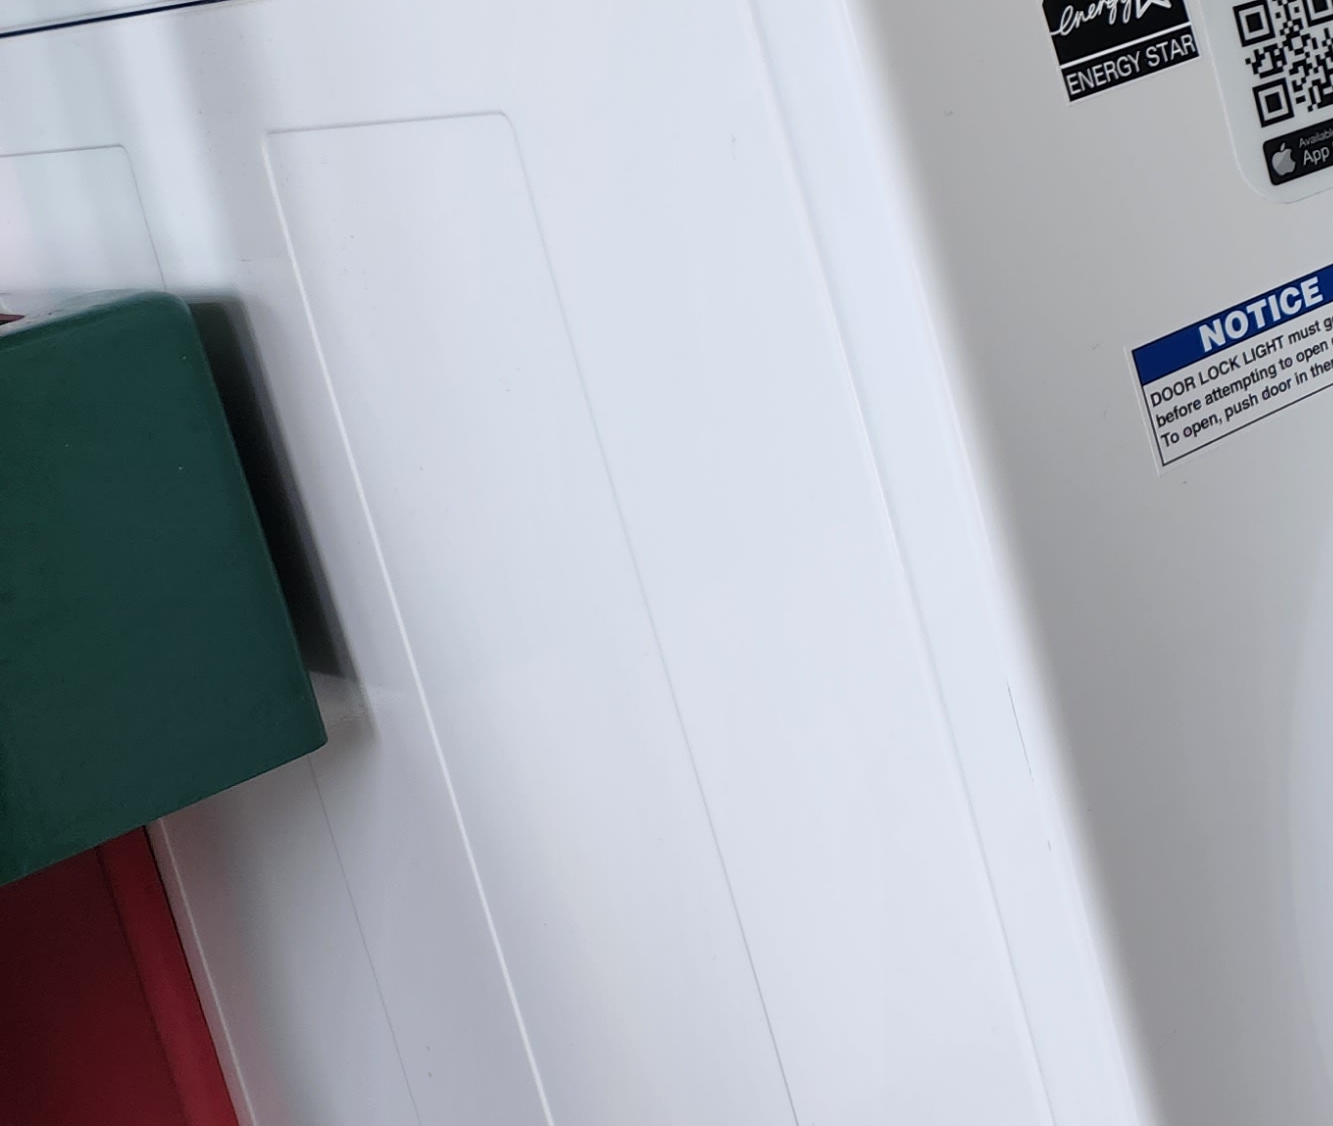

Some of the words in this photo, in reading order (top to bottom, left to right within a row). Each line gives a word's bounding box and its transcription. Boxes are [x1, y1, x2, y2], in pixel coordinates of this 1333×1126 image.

[1066, 50, 1141, 96] ENERGY
[1145, 33, 1196, 67] STAR
[1302, 147, 1330, 167] App
[1198, 276, 1325, 353] NOTICE
[1150, 376, 1197, 407] DOOR
[1199, 354, 1242, 386] LOCK
[1243, 334, 1286, 367] LIGHT
[1287, 320, 1322, 345] must
[1155, 397, 1203, 428] before
[1204, 363, 1278, 407] attempting
[1279, 354, 1294, 372] to
[1295, 341, 1330, 365] open
[1159, 431, 1180, 448] To
[1182, 412, 1224, 441] open,
[1225, 393, 1260, 423] push
[1261, 376, 1293, 401] door
[1294, 368, 1309, 386] in
